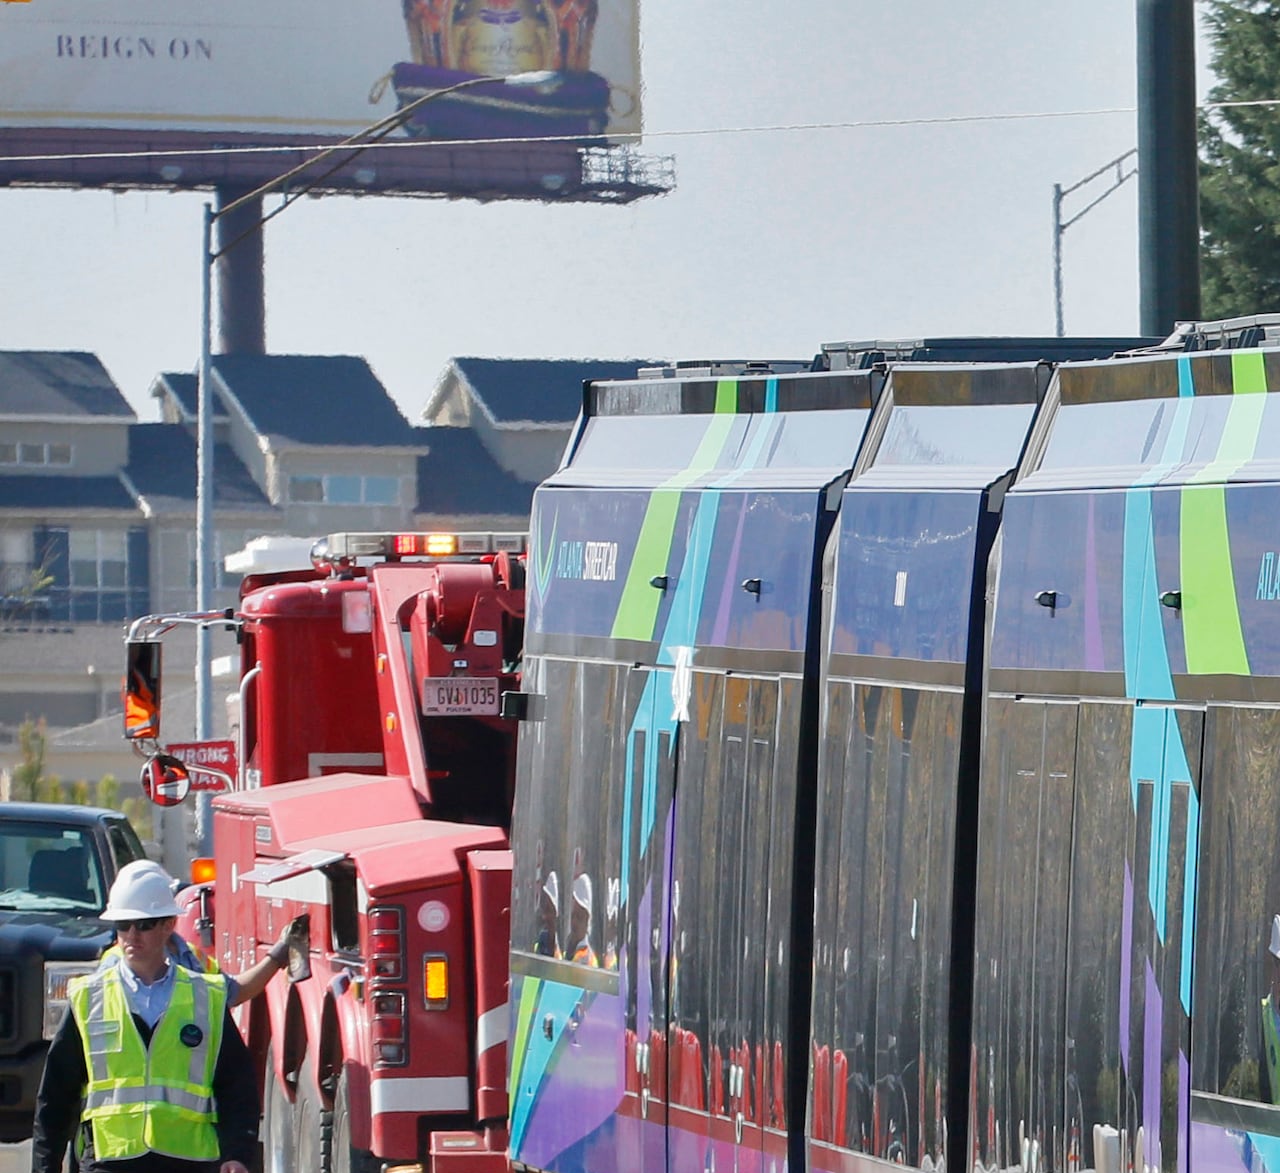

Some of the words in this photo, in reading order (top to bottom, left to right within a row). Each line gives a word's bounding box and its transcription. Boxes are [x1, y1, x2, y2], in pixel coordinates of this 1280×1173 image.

[56, 34, 156, 59] REIGN
[168, 37, 213, 60] ON
[171, 747, 230, 764] WRONG
